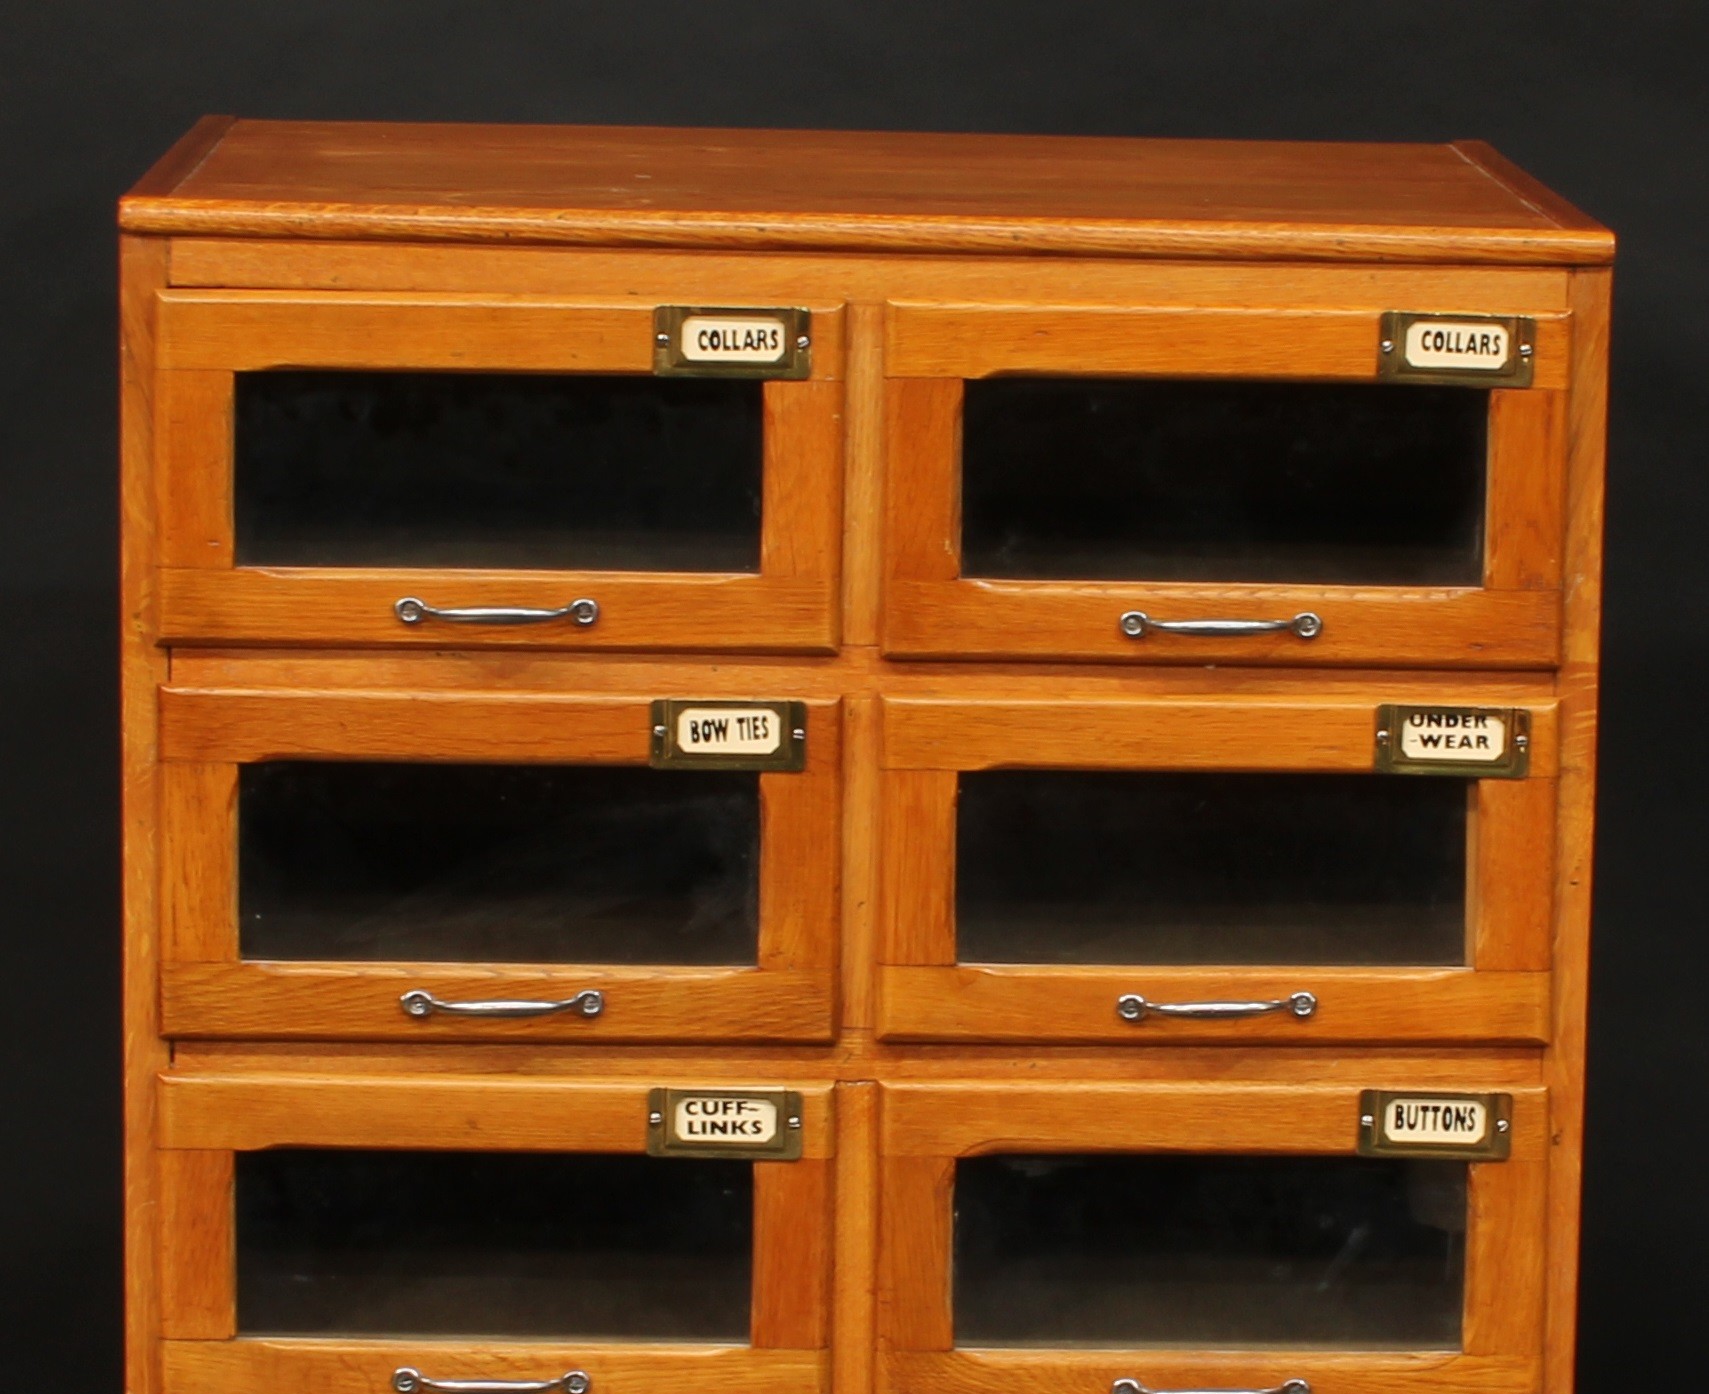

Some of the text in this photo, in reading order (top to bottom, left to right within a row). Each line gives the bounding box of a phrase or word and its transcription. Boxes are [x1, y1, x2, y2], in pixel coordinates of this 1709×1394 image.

[697, 329, 779, 351] COLLARS
[1420, 330, 1501, 356] COLLARS
[690, 715, 770, 744] BOW TIES
[1409, 712, 1488, 729] UNDER
[687, 1120, 763, 1135] LINKS
[1395, 1104, 1476, 1132] BUTTONS
